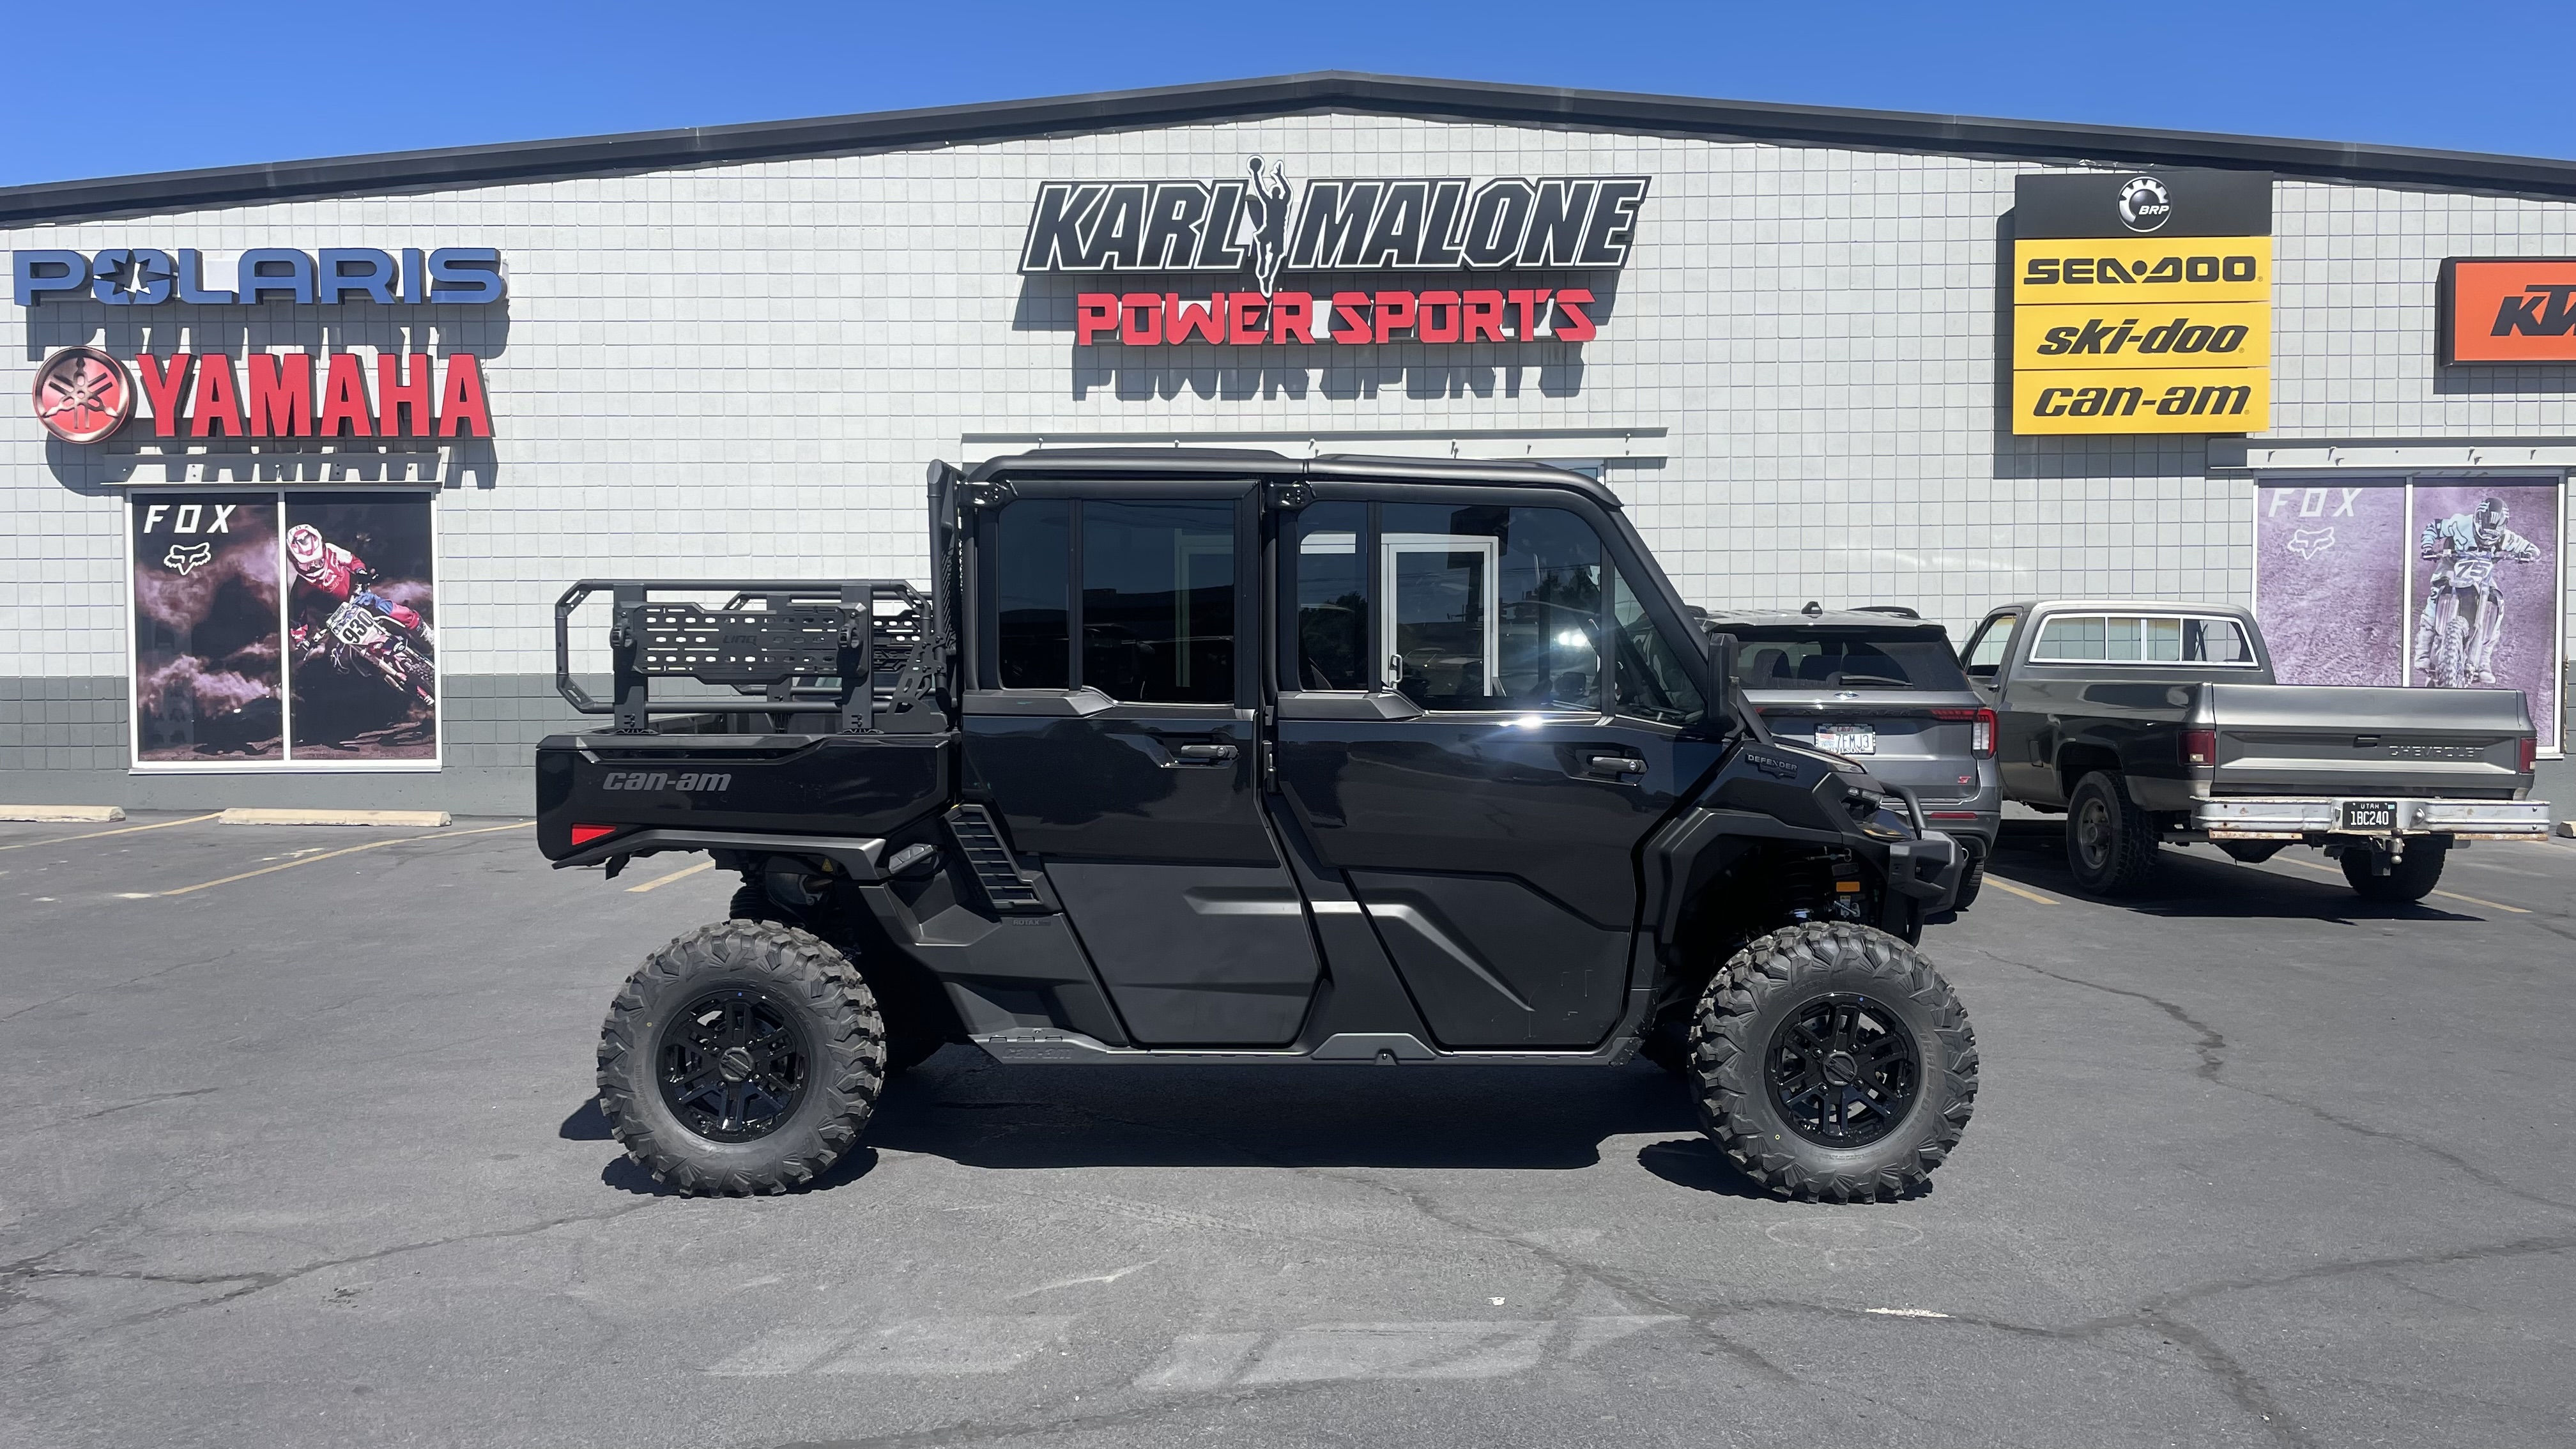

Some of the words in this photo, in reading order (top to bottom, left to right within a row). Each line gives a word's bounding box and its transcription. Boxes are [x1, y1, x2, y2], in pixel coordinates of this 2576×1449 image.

[1022, 180, 1248, 273] KARL
[1287, 177, 1651, 271] MALONE
[2138, 205, 2170, 215] BRP
[13, 247, 503, 306] POLARIS
[1078, 291, 1315, 346] POWER
[1331, 289, 1597, 343] SPORTS
[2490, 284, 2576, 336] KT
[2037, 318, 2249, 354] ski-doo
[135, 353, 493, 437] YAMAHA
[2033, 385, 2251, 417] can-am
[143, 504, 236, 533] FOX
[2268, 488, 2363, 518] FOX
[342, 610, 374, 643] 930
[1747, 754, 1798, 771] DEFENDER
[2389, 746, 2485, 758] CHEVROLET
[602, 772, 732, 792] can-am
